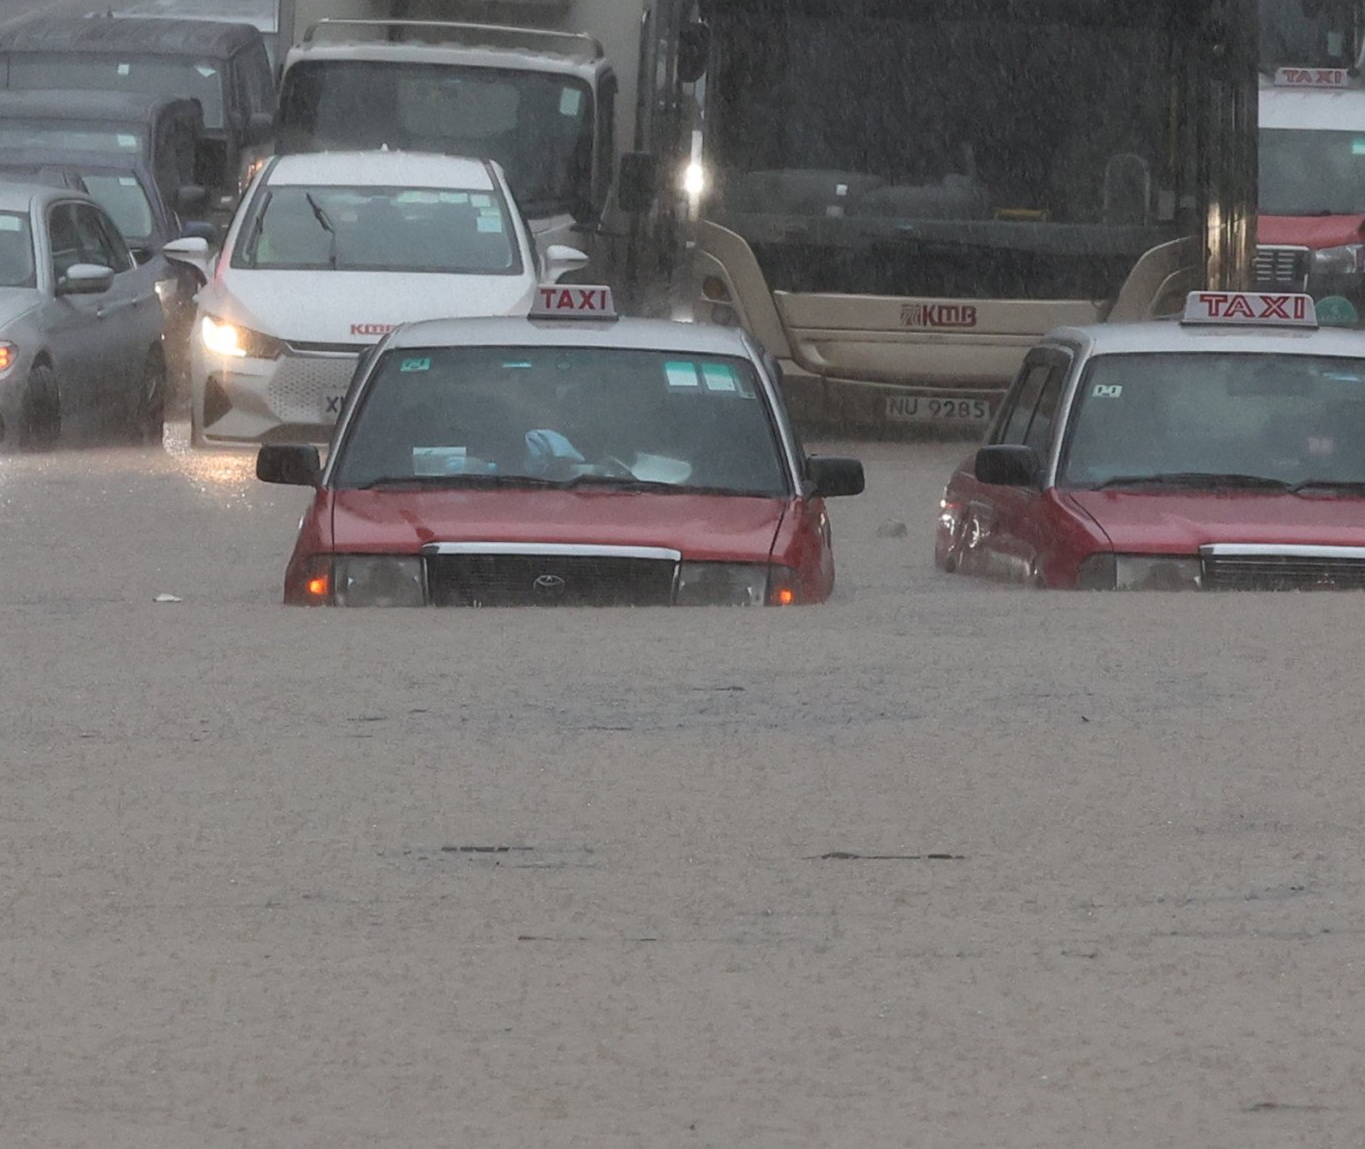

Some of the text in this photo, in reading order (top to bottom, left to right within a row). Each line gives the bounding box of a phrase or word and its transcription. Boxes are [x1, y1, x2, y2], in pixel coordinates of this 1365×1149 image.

[1282, 69, 1343, 84] TAXI
[540, 288, 607, 310] TAXI
[1199, 293, 1306, 319] TAXI
[923, 304, 978, 327] KMB
[888, 398, 986, 419] NU 9285
